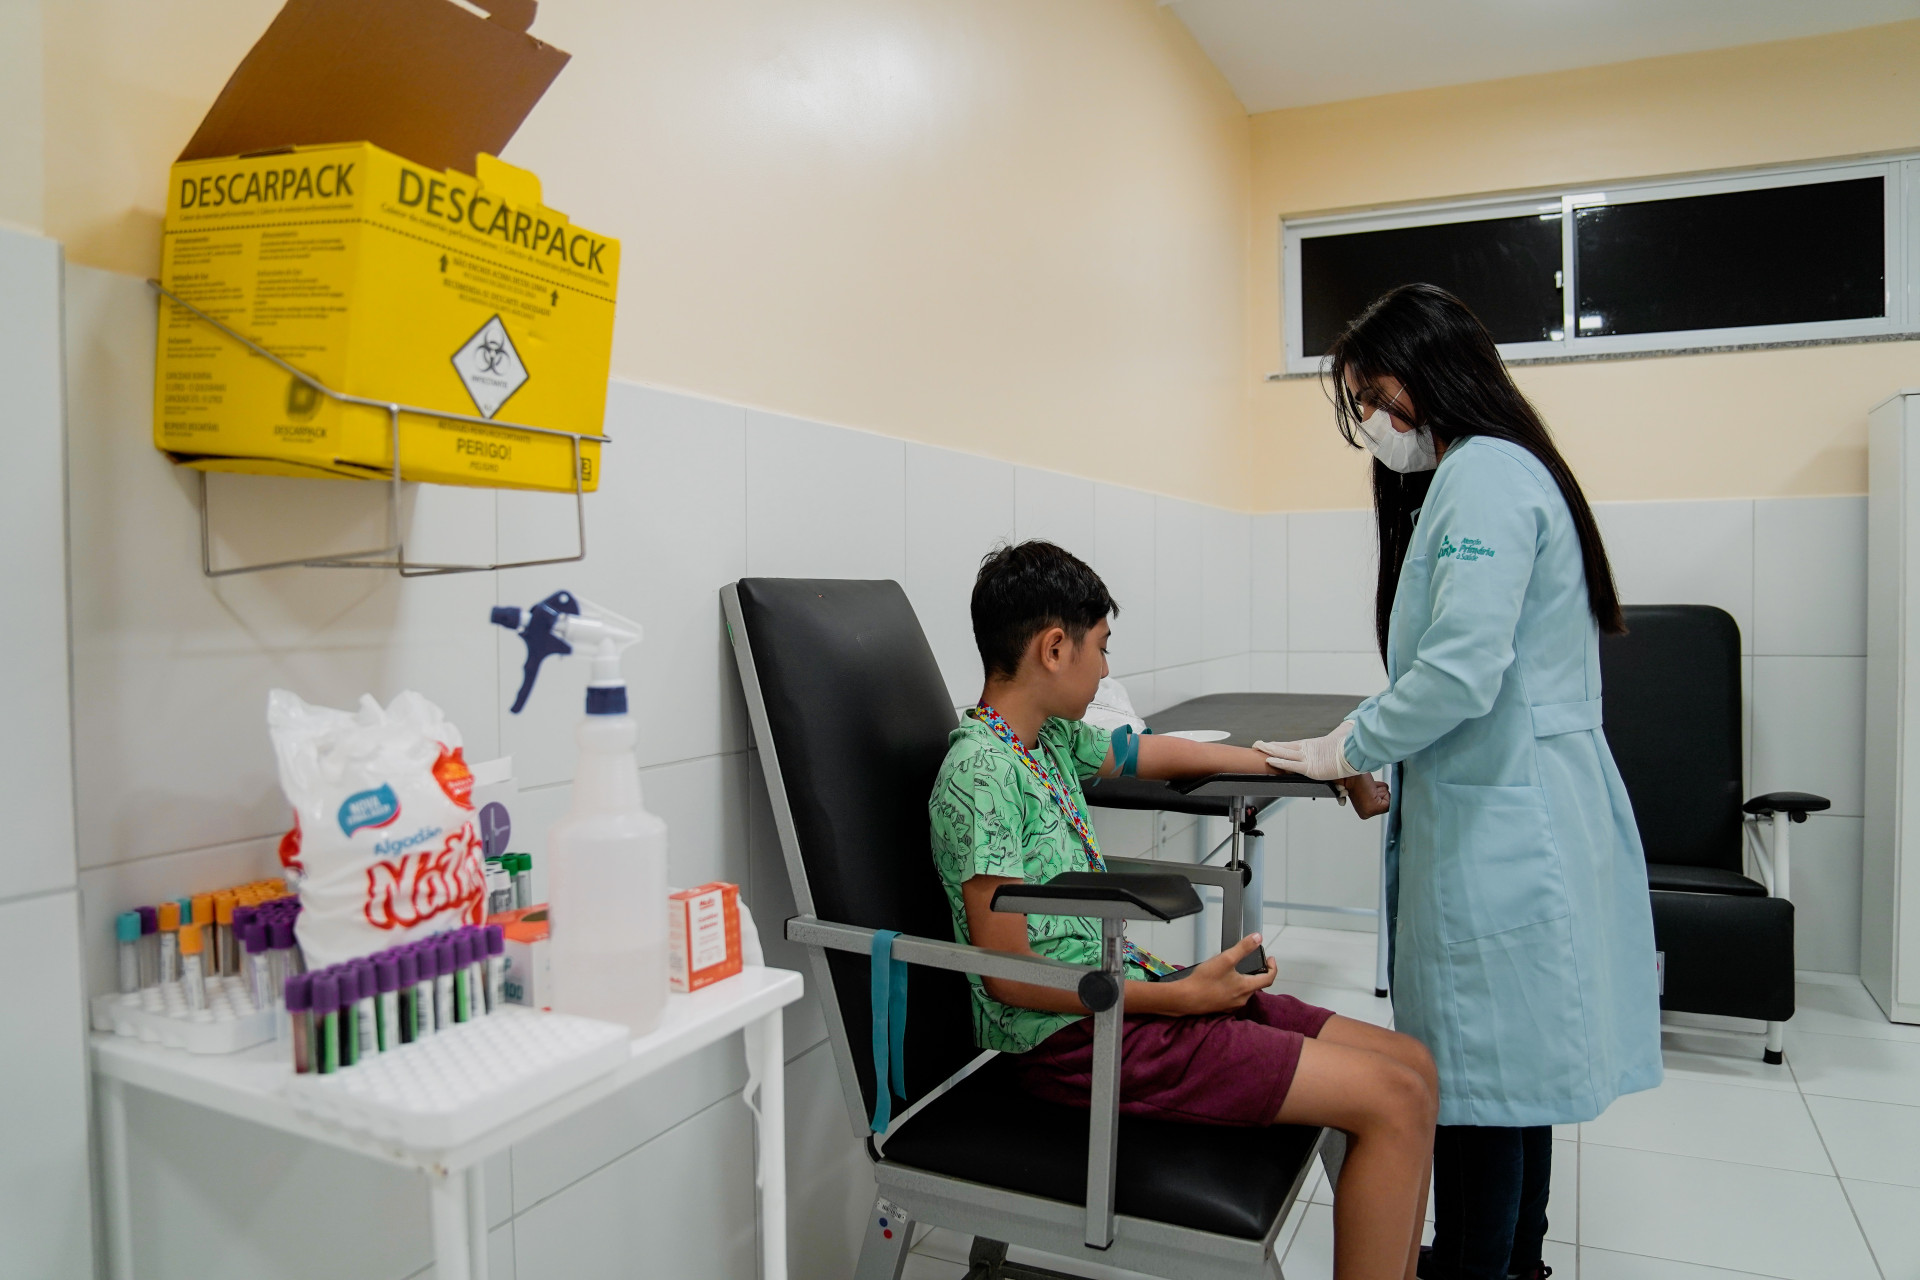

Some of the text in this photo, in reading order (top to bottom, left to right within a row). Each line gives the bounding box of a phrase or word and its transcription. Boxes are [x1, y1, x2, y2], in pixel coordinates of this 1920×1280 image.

[180, 162, 356, 209] DESCARPACK
[398, 168, 607, 274] DESCARPACK
[456, 437, 512, 461] PERIGO!
